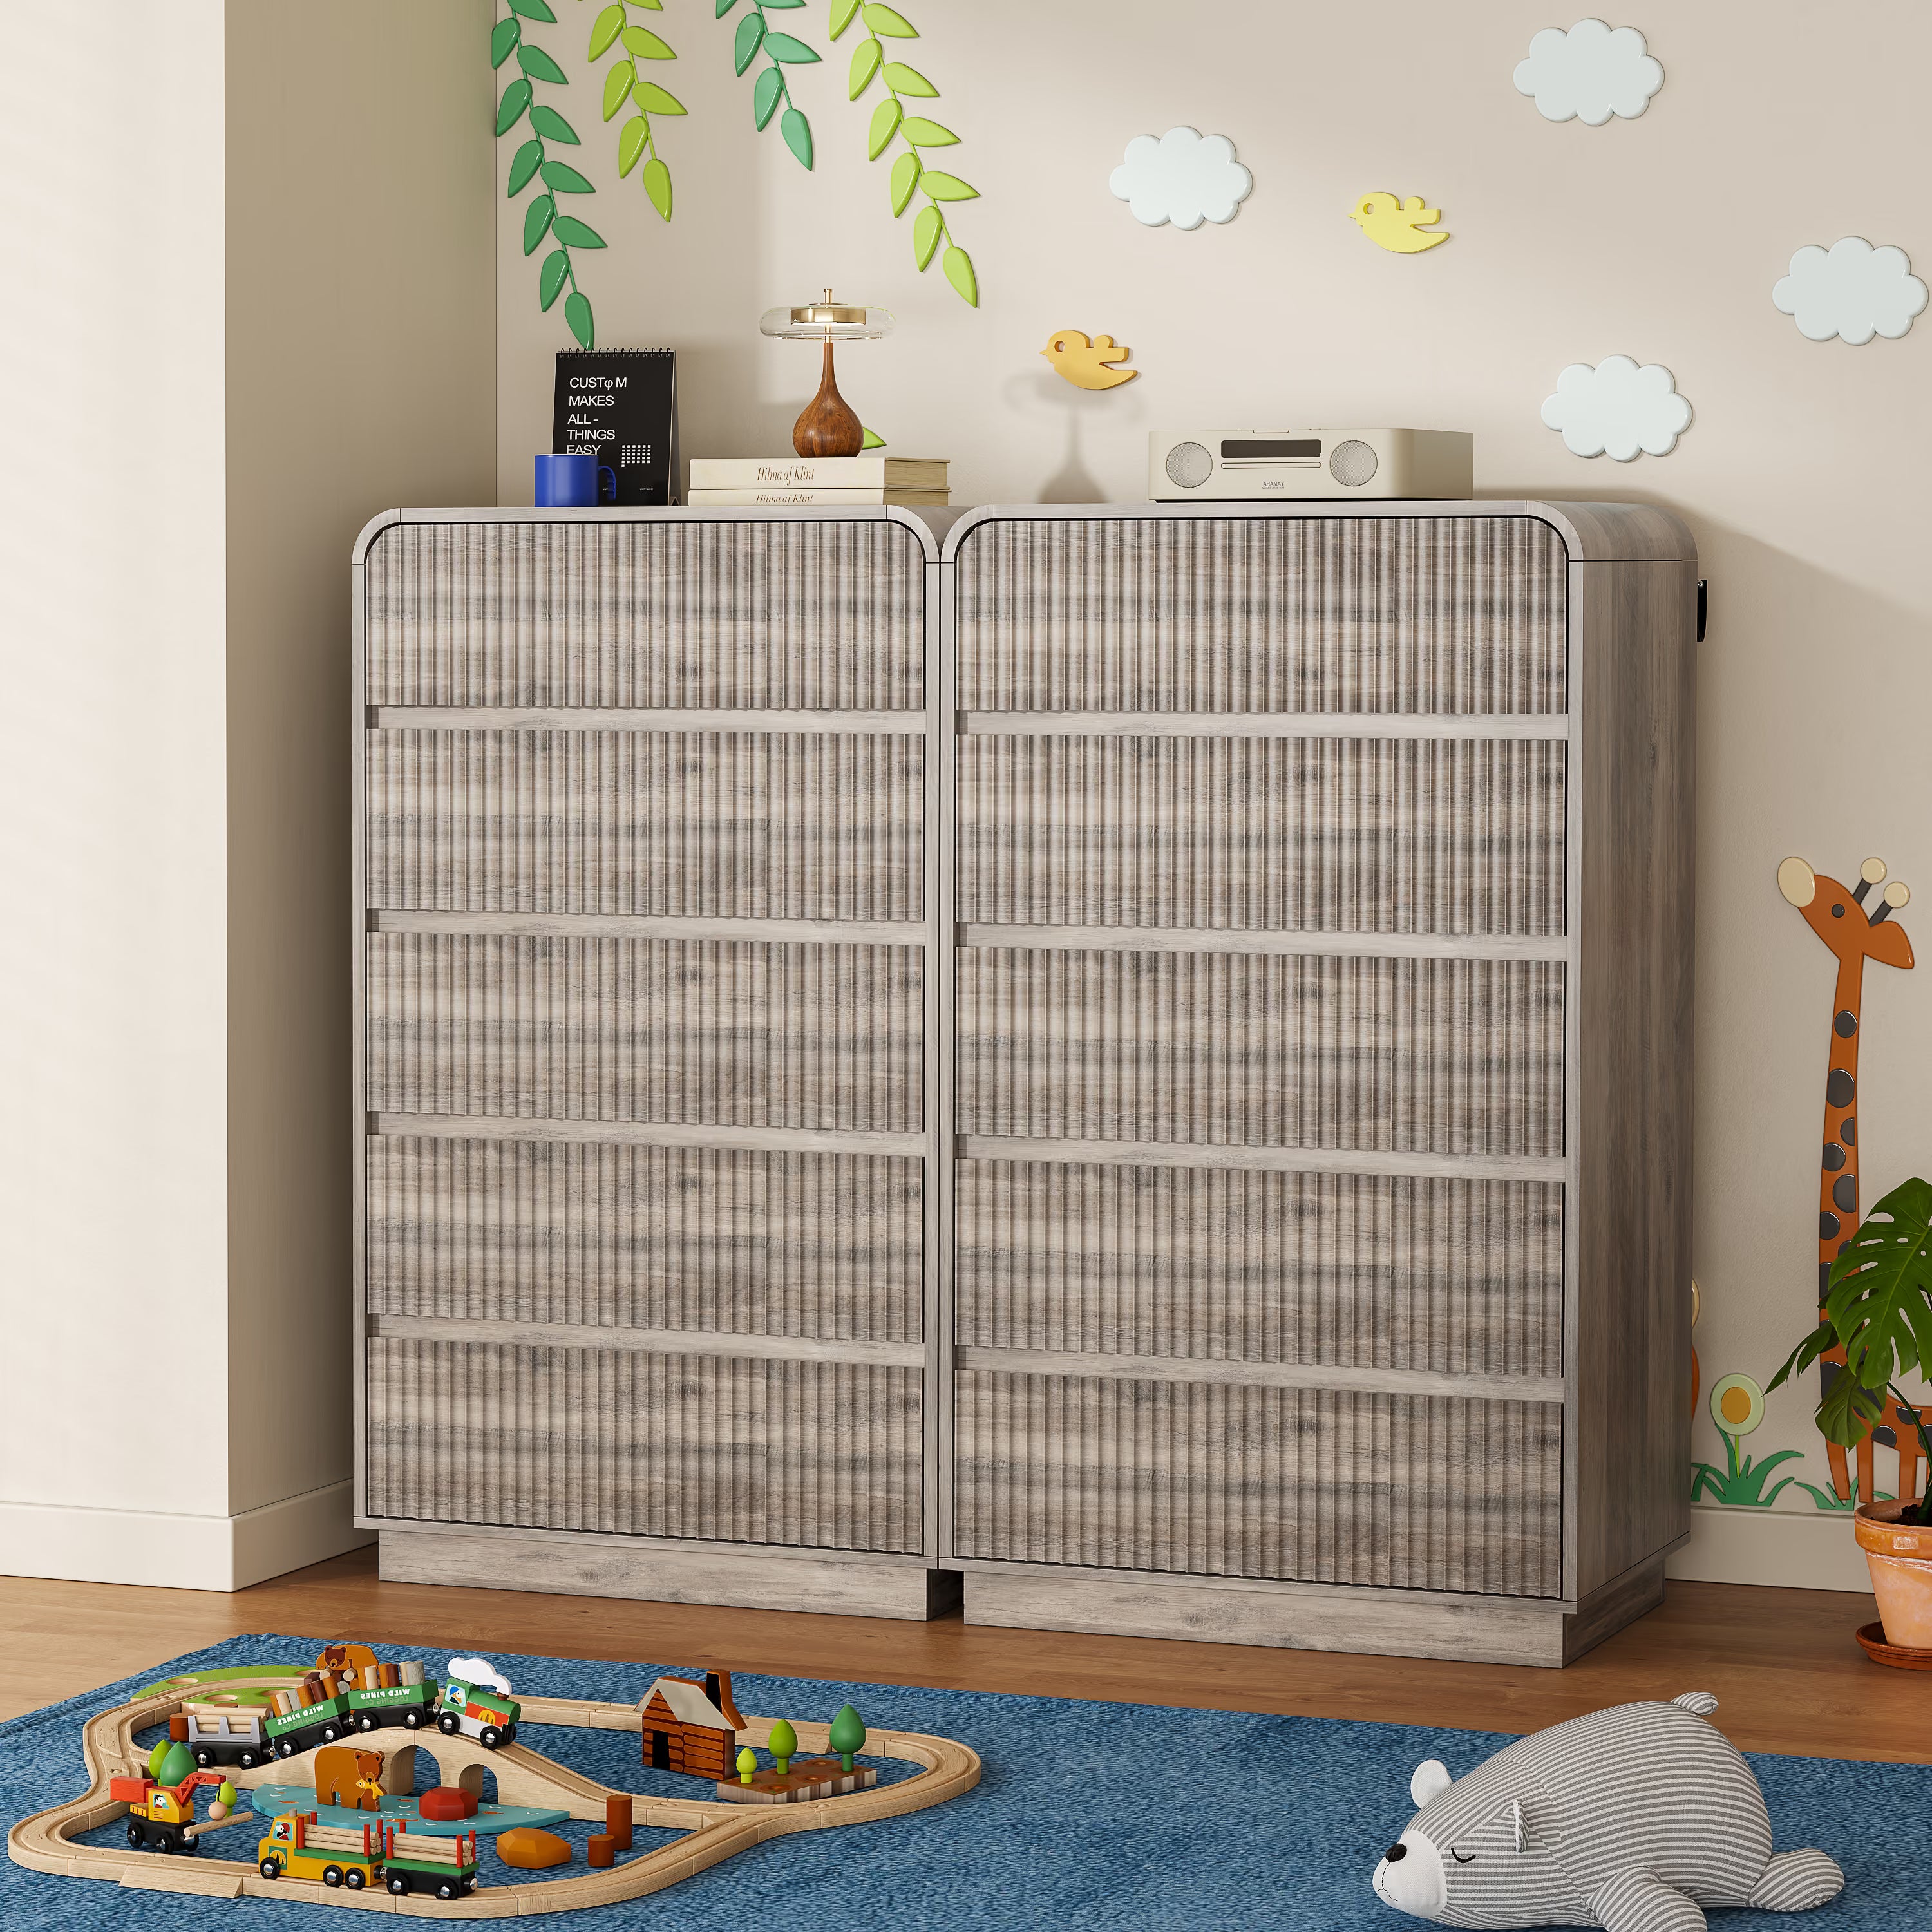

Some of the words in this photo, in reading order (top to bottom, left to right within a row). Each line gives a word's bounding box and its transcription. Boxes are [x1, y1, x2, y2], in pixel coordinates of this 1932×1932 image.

[569, 395, 614, 406] MAKES
[567, 413, 591, 424] ALL
[567, 429, 616, 440] THINGS
[566, 444, 601, 455] EASY
[757, 466, 782, 481] Hilma
[783, 466, 793, 485] af
[793, 466, 815, 481] Klint
[756, 494, 781, 503] Hilma
[782, 494, 793, 505] af
[793, 493, 813, 502] Klint
